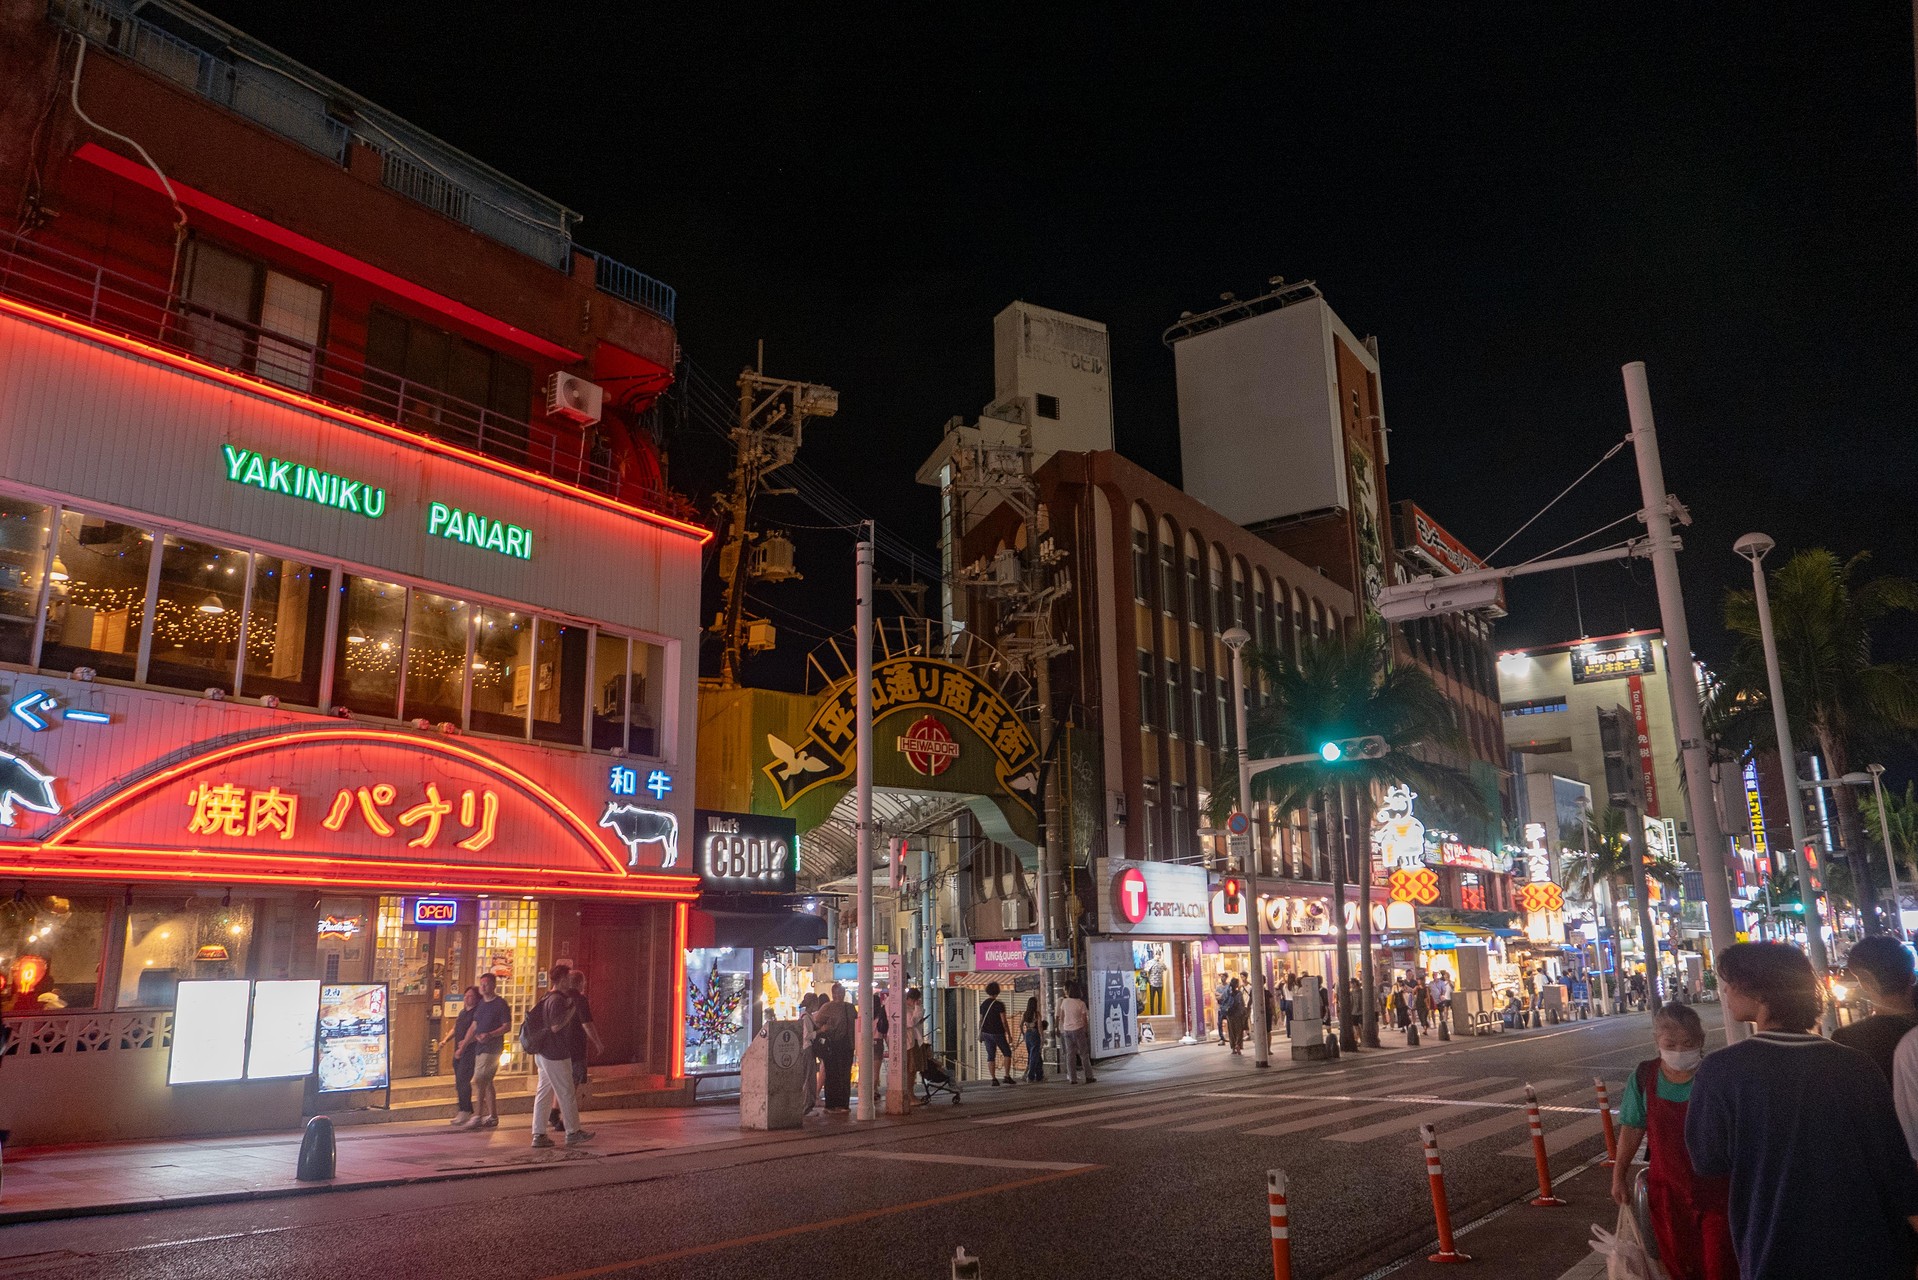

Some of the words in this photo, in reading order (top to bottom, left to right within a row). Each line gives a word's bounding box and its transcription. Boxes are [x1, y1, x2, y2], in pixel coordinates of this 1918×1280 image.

[221, 443, 387, 519] YAKINIKU
[428, 501, 533, 561] PANARI
[1633, 690, 1641, 704] Tax
[818, 661, 1030, 764] 平和通り商店街
[1635, 704, 1643, 721] Free
[901, 737, 959, 757] HEIWADORI
[611, 764, 674, 800] 和牛
[1643, 771, 1652, 785] Tax
[1645, 786, 1654, 803] Free
[187, 781, 299, 840] 焼肉
[322, 782, 501, 852] パナリ
[707, 816, 741, 834] What's
[710, 834, 789, 880] CBD!?
[1125, 879, 1145, 917] T
[1147, 901, 1207, 919] T-SHIRT-YA.COM
[418, 904, 454, 920] OPEN
